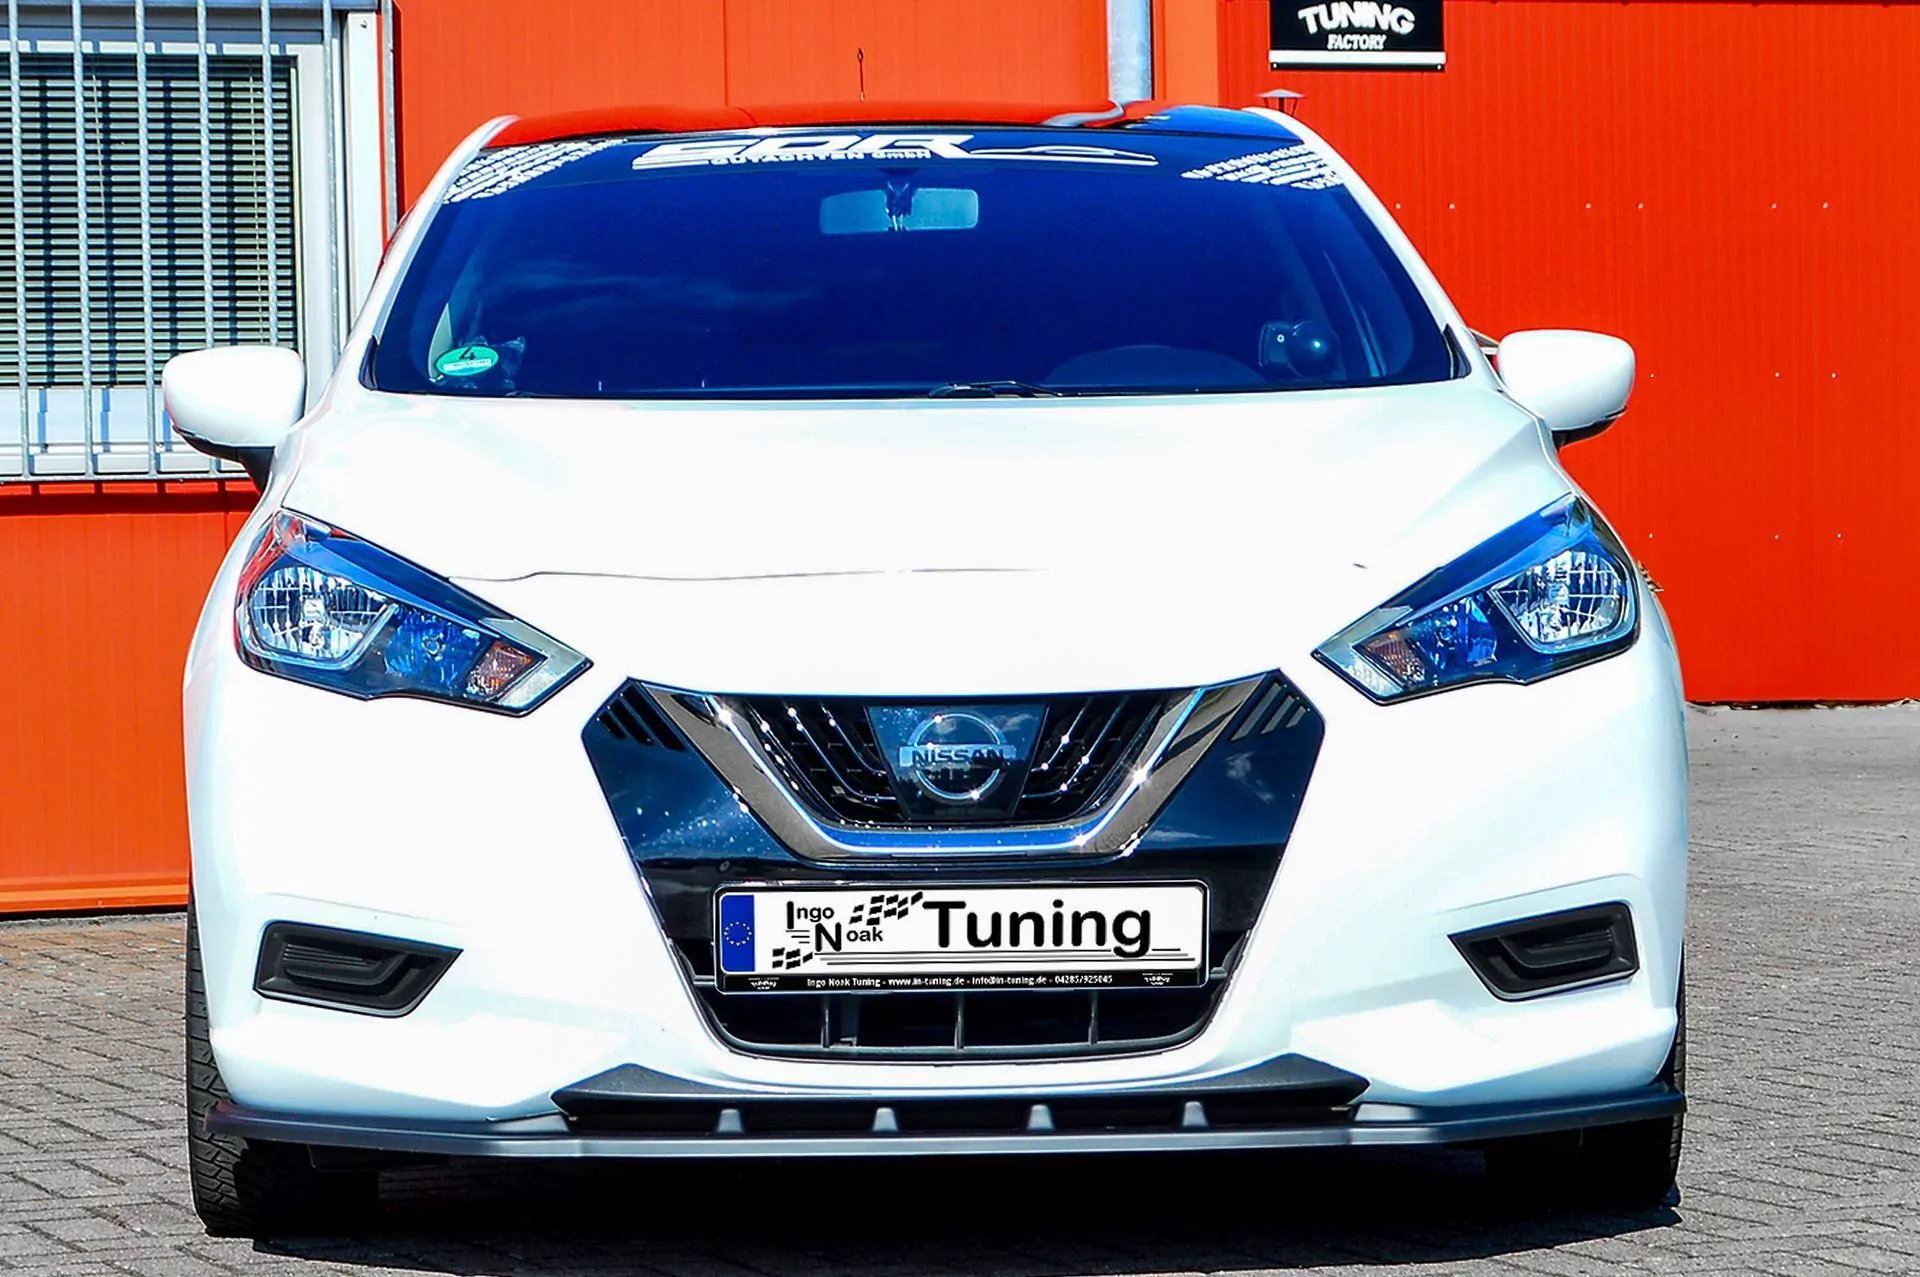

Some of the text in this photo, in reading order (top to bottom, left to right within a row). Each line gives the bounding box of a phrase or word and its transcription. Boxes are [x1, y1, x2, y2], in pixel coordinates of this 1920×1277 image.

[1297, 1, 1416, 35] TUNING
[1327, 34, 1387, 50] FACTORY
[458, 346, 476, 361] 4
[911, 747, 1004, 767] NISSAN
[786, 901, 835, 930] Ingo
[815, 922, 883, 952] Noak
[922, 899, 1151, 958] Tuning
[807, 978, 826, 988] Ingo
[852, 977, 880, 987] Tuning
